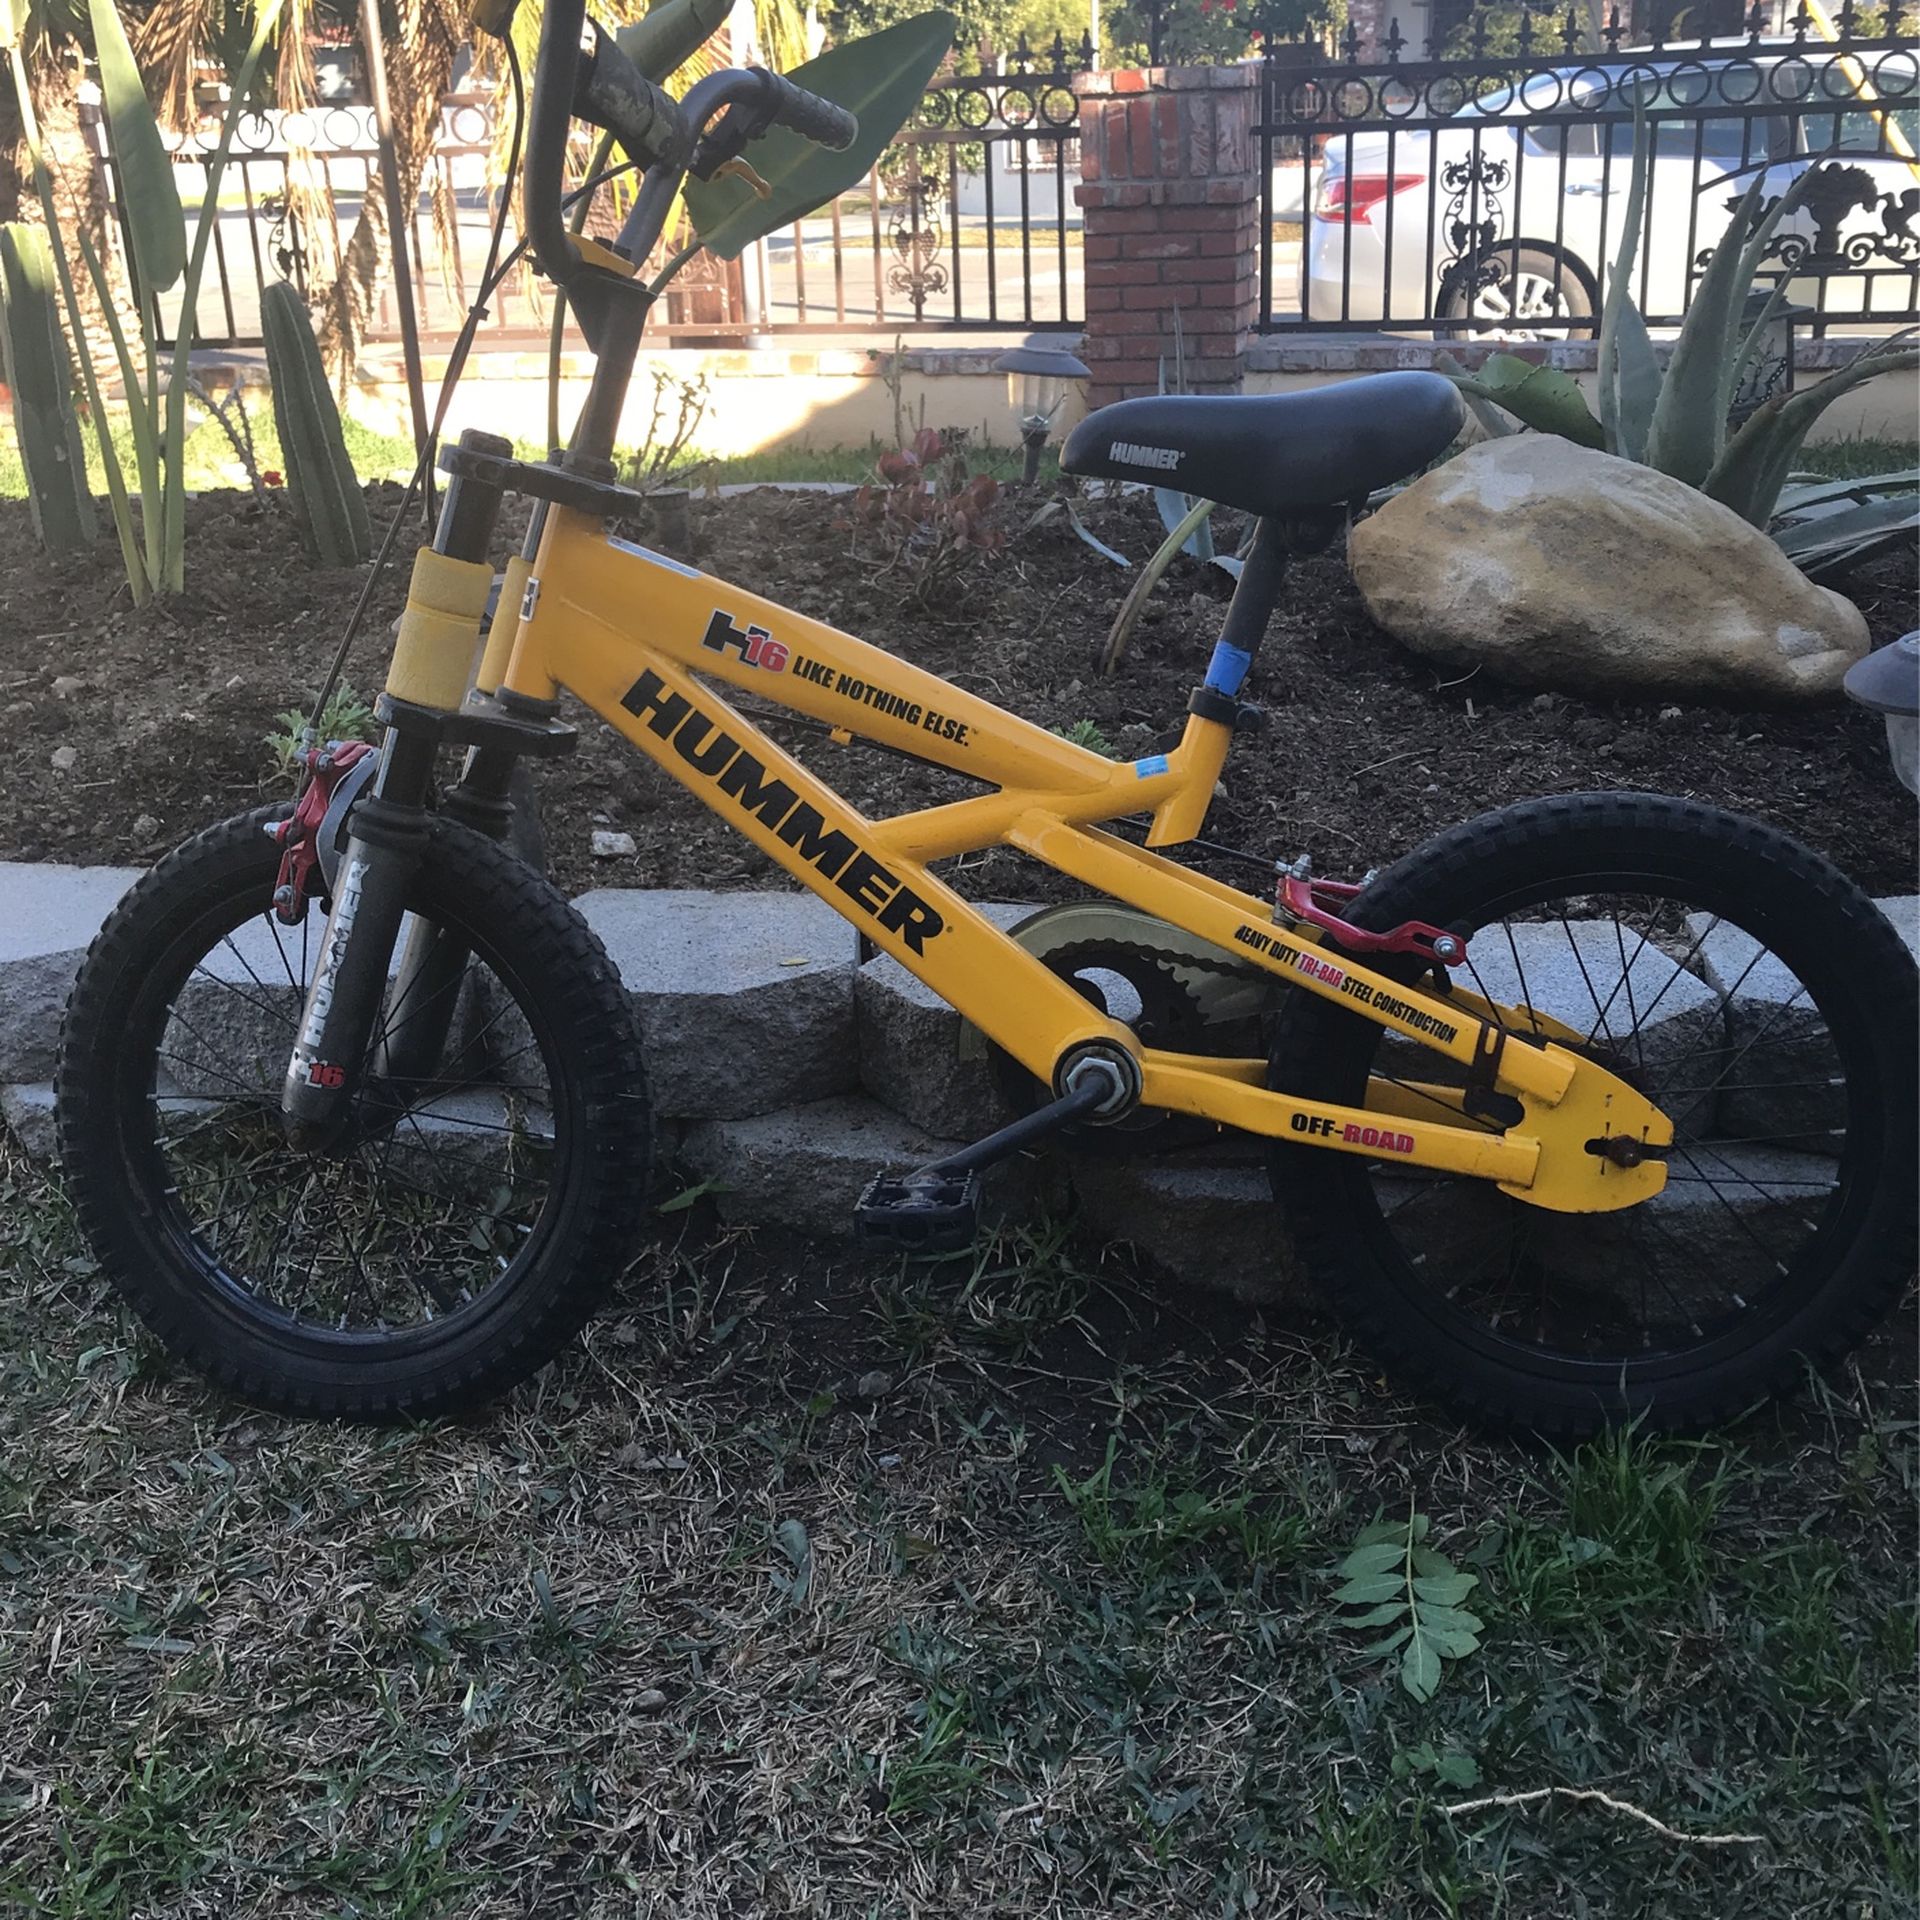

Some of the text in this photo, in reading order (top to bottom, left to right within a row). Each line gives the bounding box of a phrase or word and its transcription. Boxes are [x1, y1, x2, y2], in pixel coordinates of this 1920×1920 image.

[1109, 441, 1178, 470] HUMMER
[792, 655, 836, 689] LIKE
[834, 673, 922, 726] NOTHING
[620, 668, 944, 958] HUMMER
[1234, 924, 1458, 1044] HEAVY DUTY TRI-BAR STEEL CONSTRUCTION
[1291, 1113, 1415, 1153] OFF-ROAD
